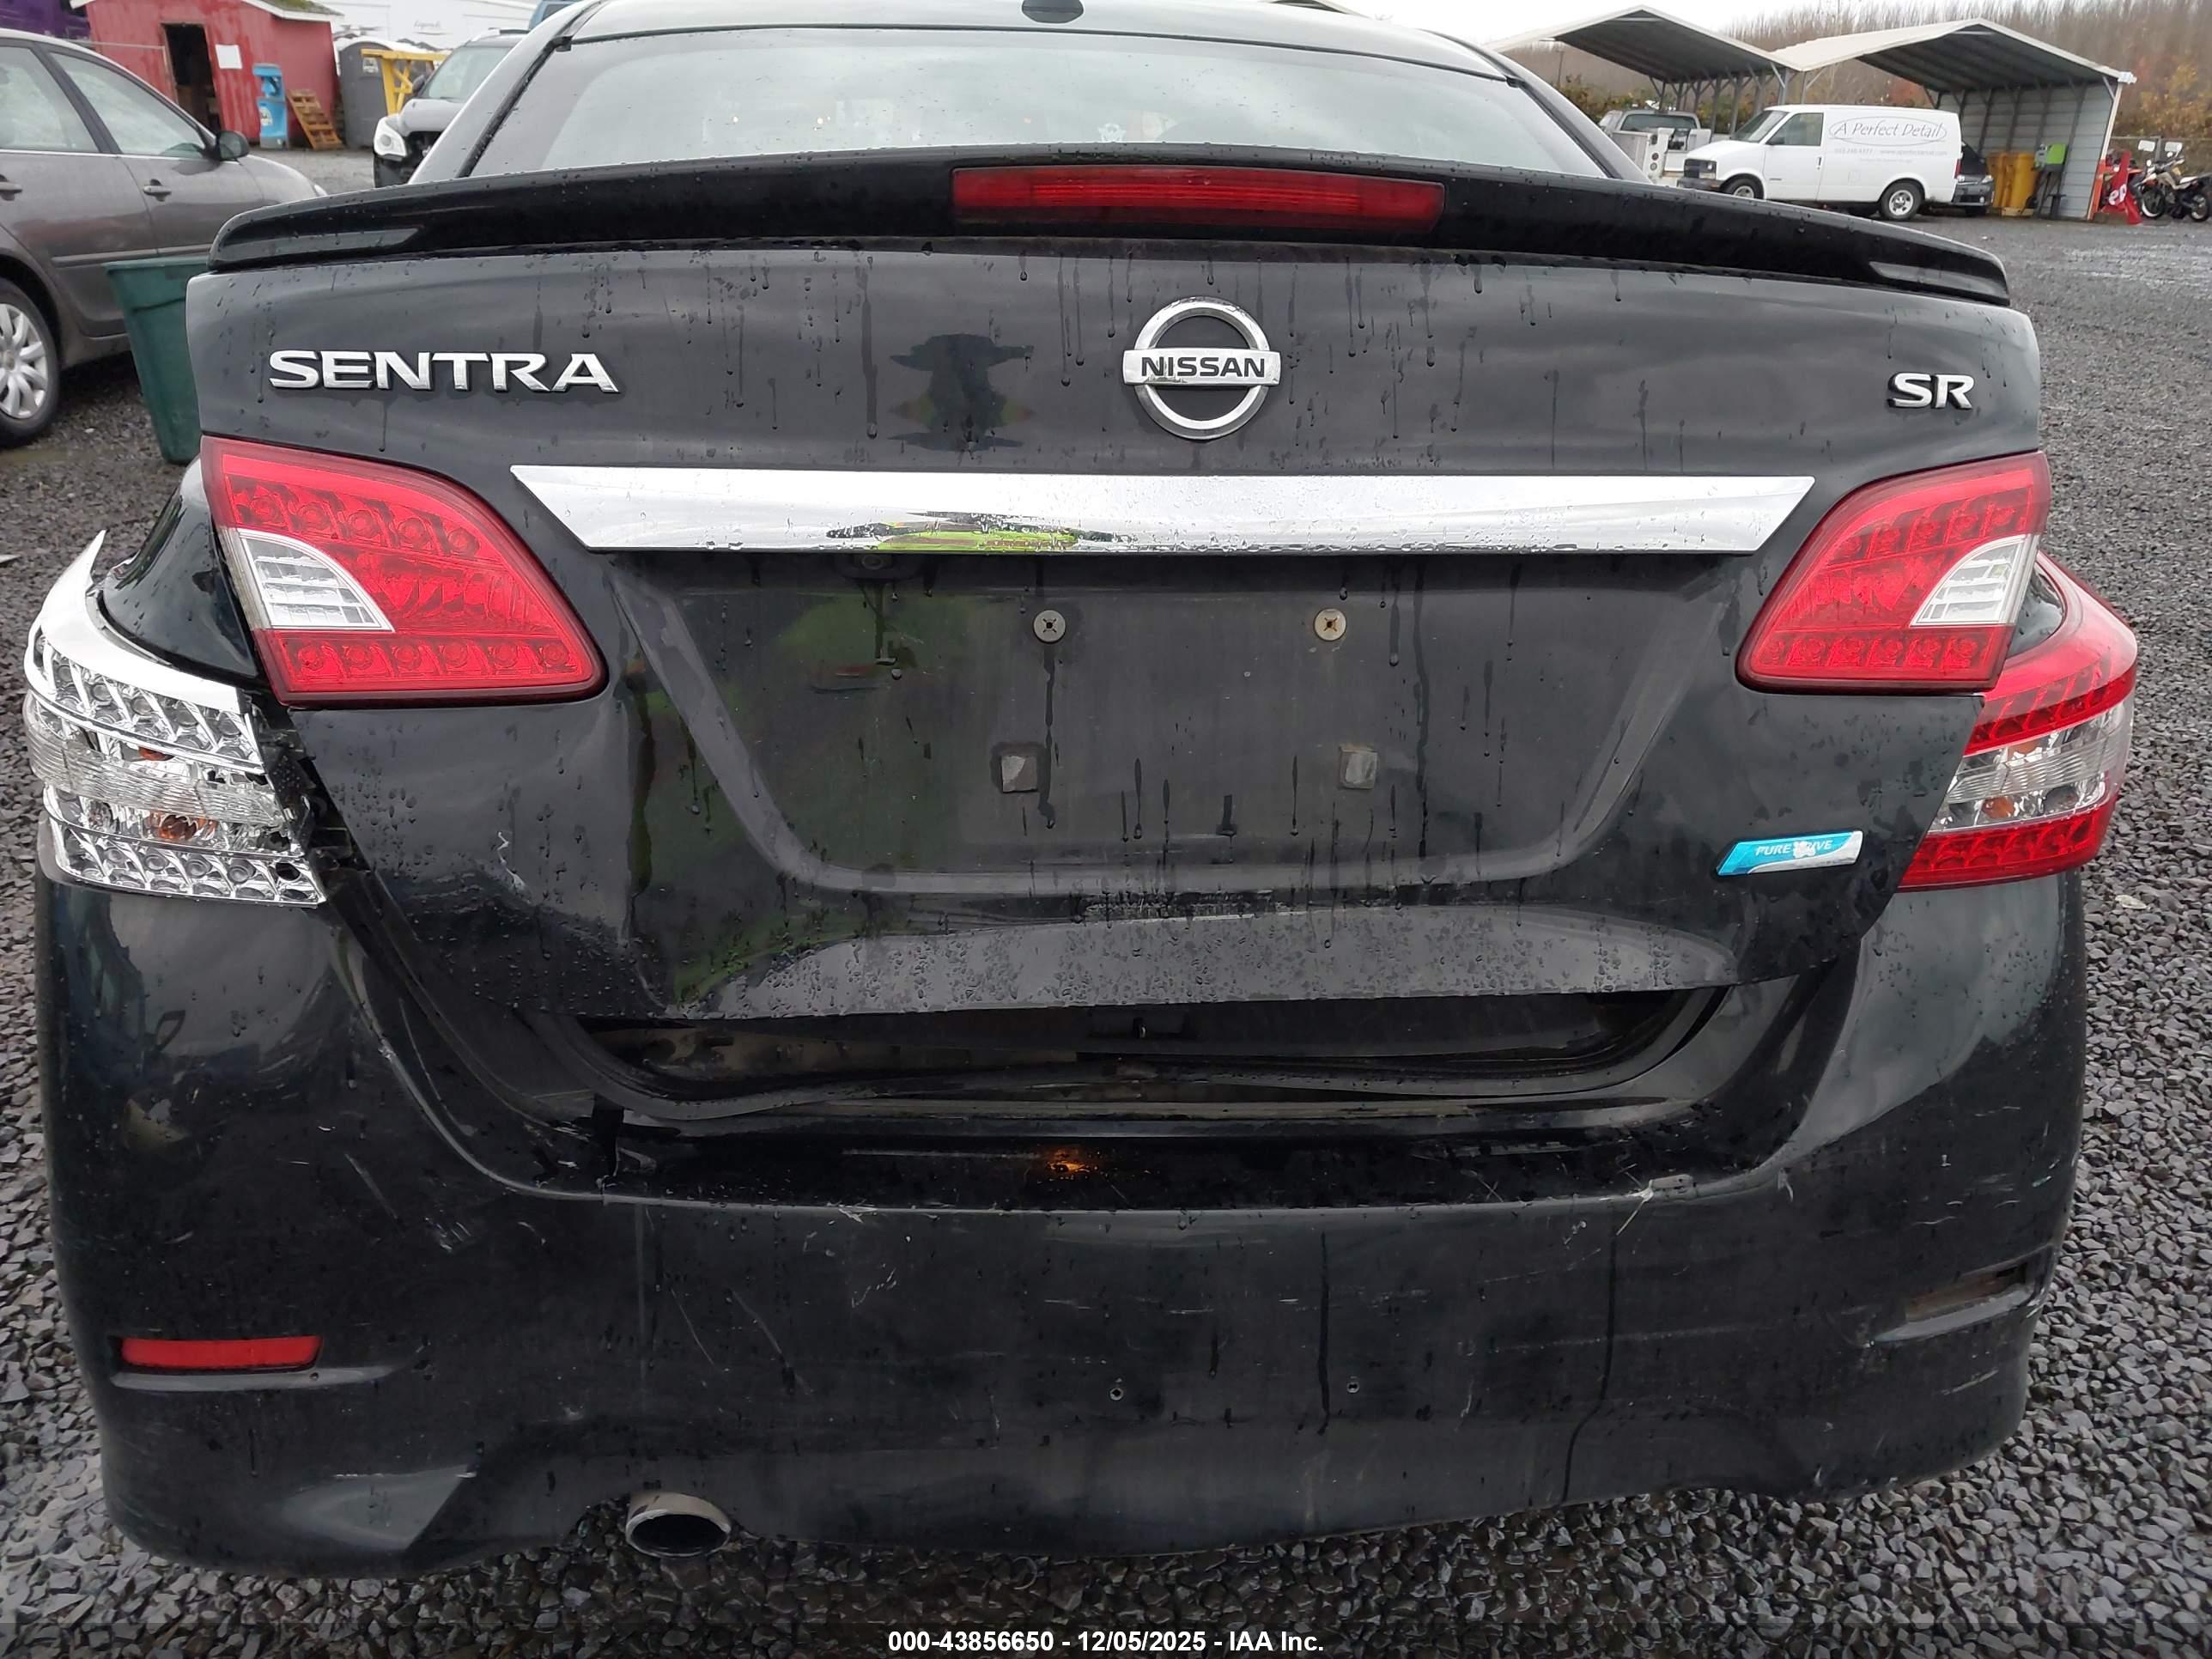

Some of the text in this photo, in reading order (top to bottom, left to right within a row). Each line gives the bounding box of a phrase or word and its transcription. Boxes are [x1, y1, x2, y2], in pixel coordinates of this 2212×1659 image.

[1834, 119, 1942, 137] A Perfect Detail
[269, 349, 620, 393] SENTRA
[1141, 356, 1265, 377] NISSAN
[1888, 372, 1974, 410] SR
[1755, 844, 1792, 856] PURE
